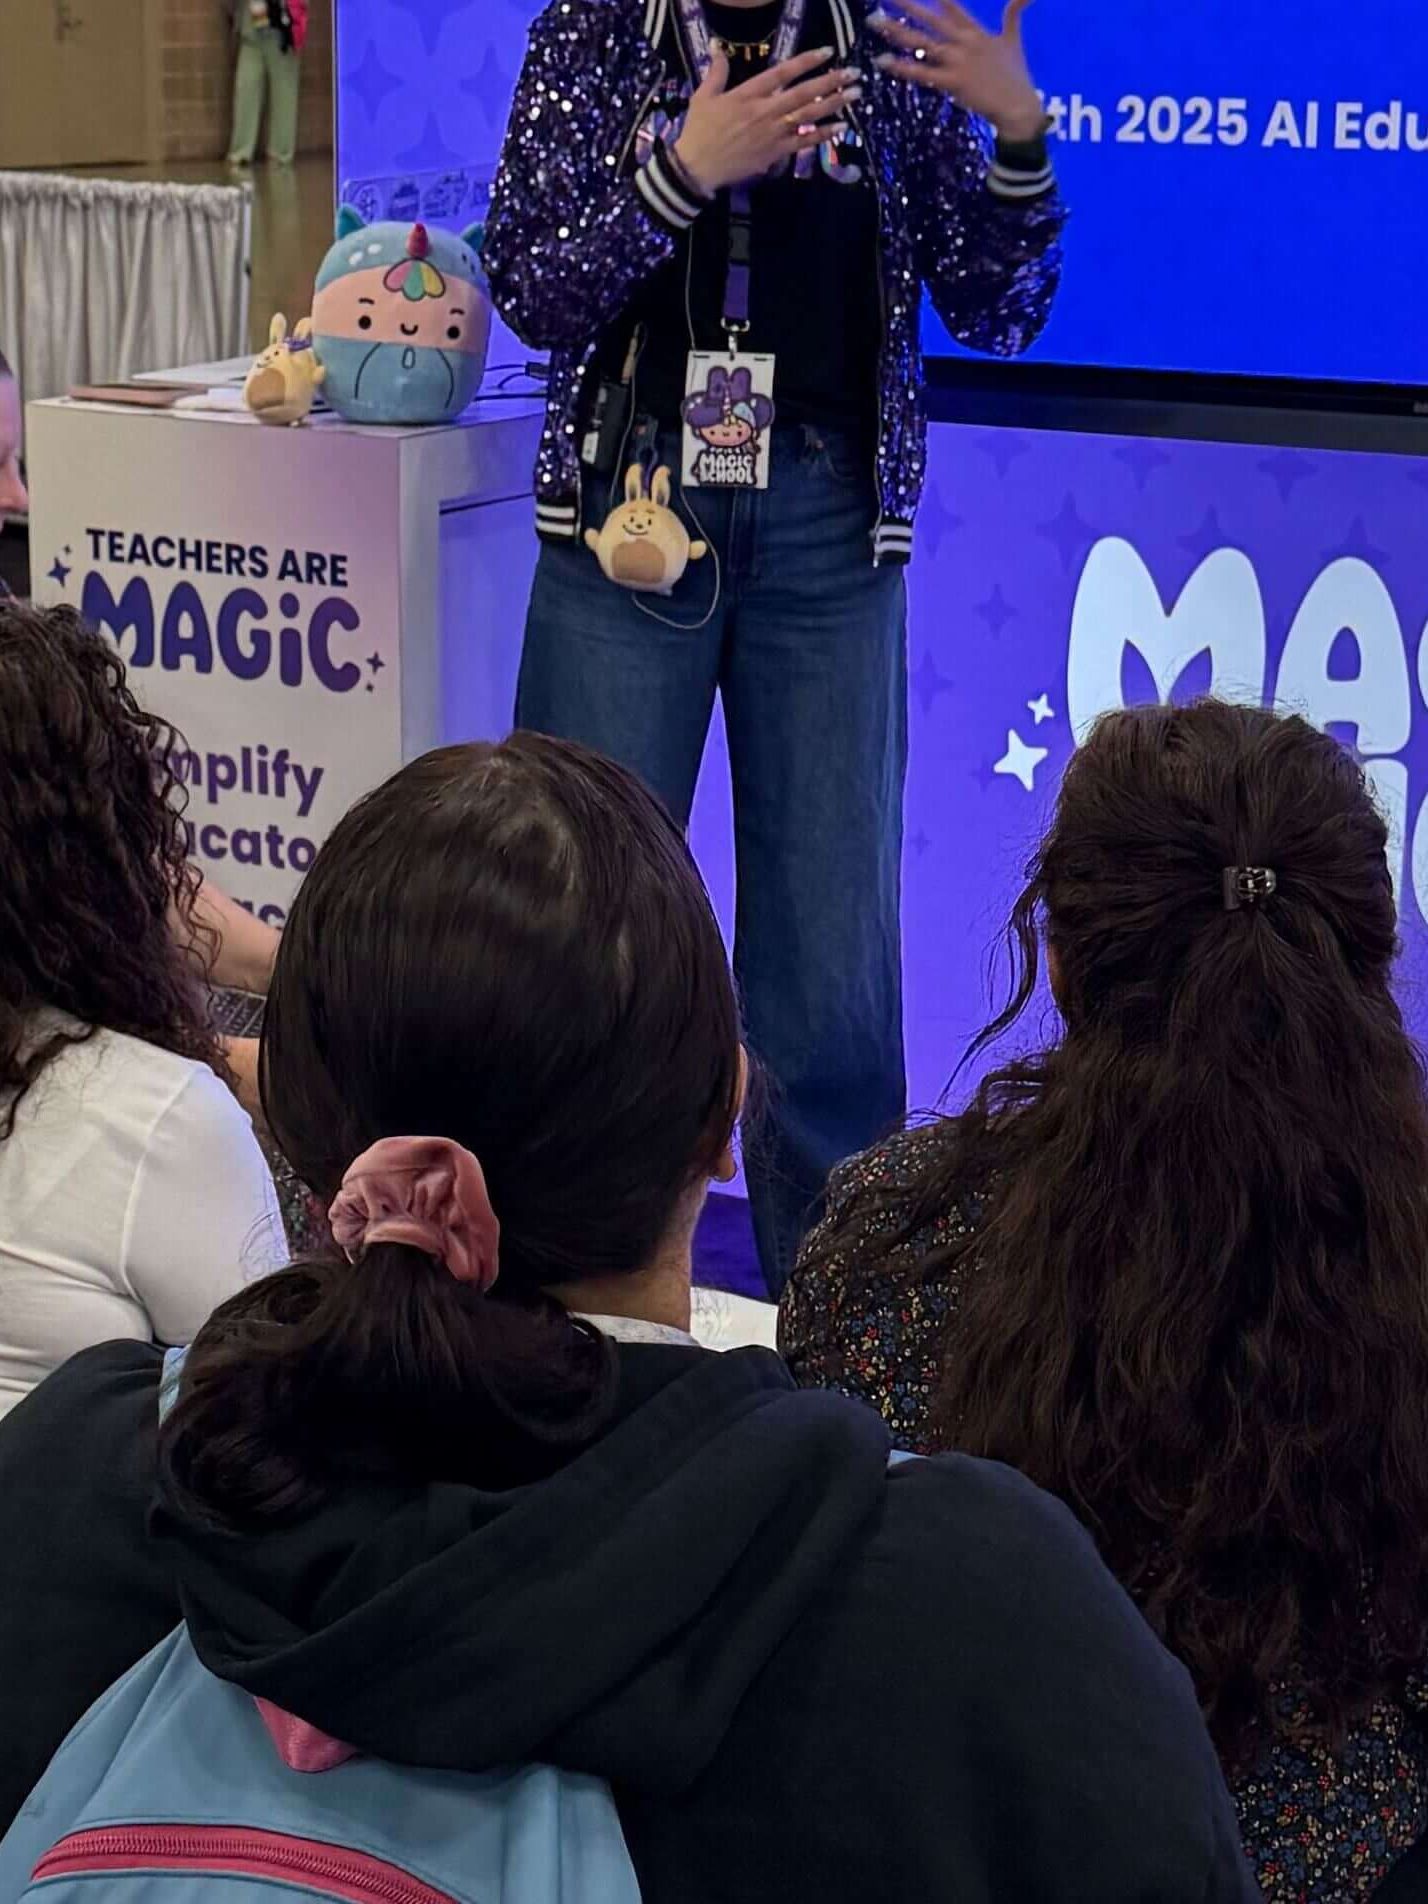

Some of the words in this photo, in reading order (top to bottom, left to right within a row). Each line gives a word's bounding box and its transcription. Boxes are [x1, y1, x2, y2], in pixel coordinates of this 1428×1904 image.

[1036, 88, 1102, 144] th
[1115, 94, 1248, 145] 2025
[1261, 100, 1320, 149] AI
[85, 527, 269, 579] TEACHERS
[277, 548, 348, 588] ARE
